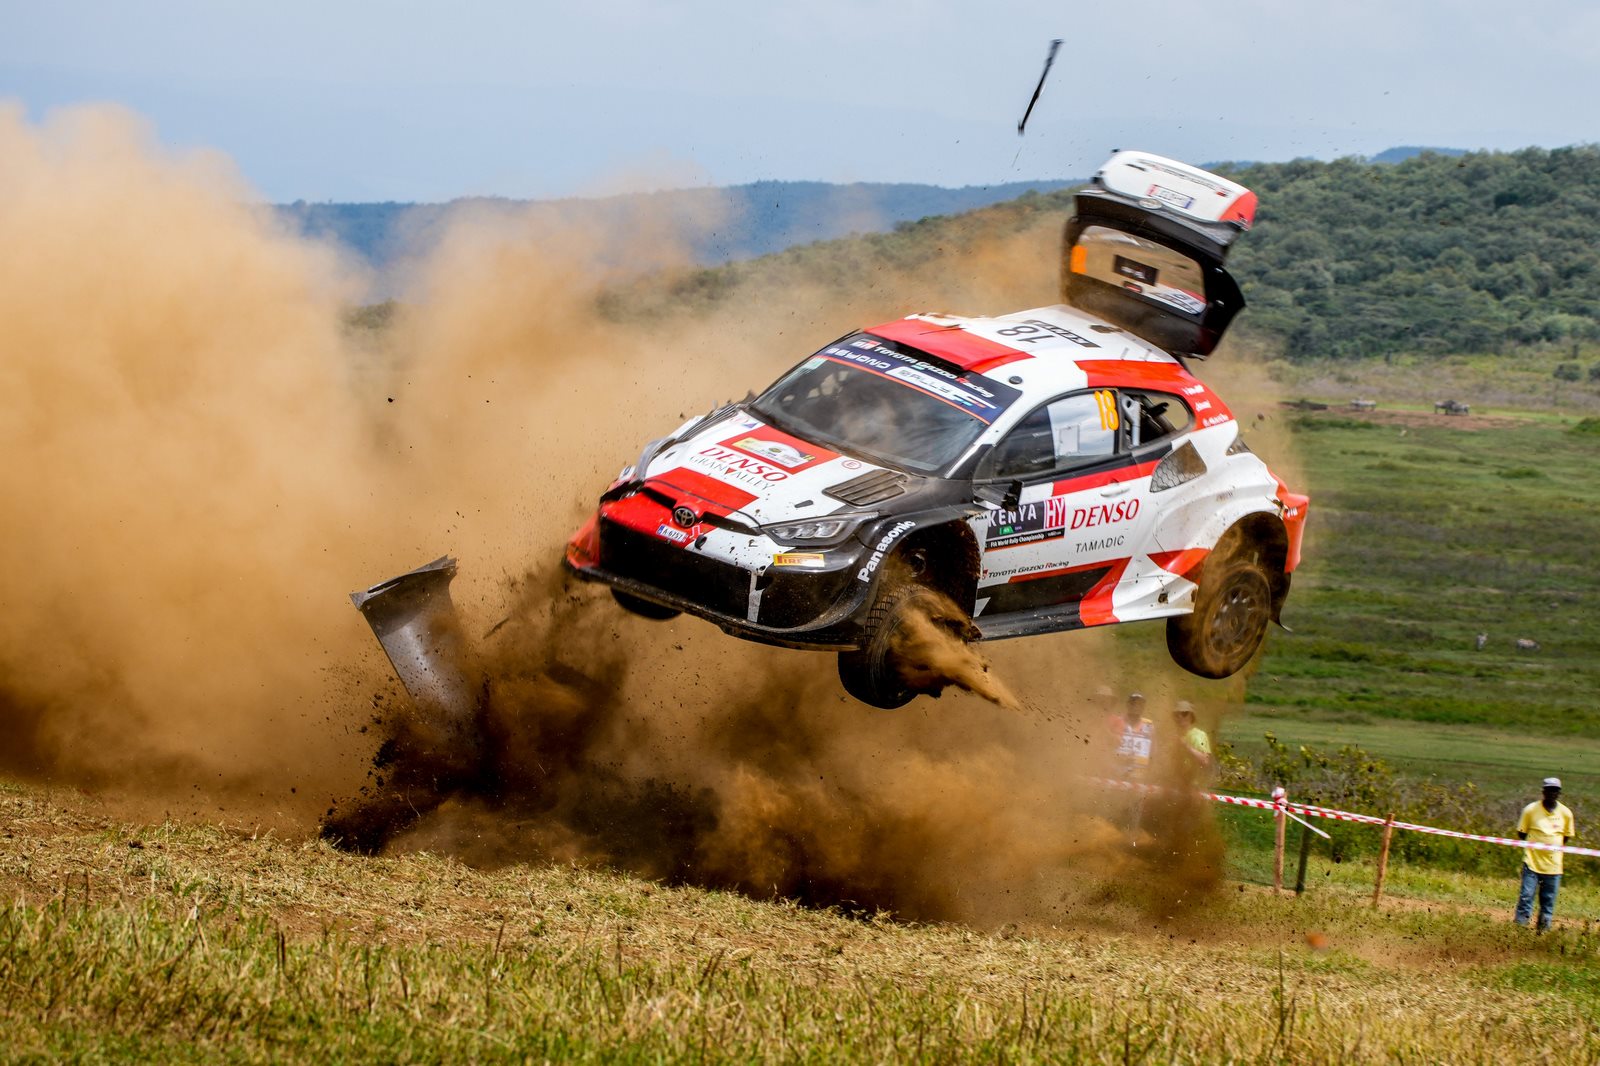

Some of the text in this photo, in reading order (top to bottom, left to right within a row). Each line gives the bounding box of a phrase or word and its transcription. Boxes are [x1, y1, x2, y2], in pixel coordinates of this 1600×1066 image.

[996, 326, 1056, 343] 18
[825, 347, 891, 369] BEYOND
[874, 346, 919, 364] TOYOTA
[912, 361, 958, 380] GAZOO
[955, 377, 995, 398] Racing
[1094, 389, 1119, 431] 18
[698, 447, 788, 482] DENSO
[988, 498, 1065, 529] KENYA HY
[1071, 499, 1139, 530] DENSO
[857, 520, 916, 583] Panasonic
[998, 539, 1009, 547] World
[1019, 533, 1045, 543] Championship
[1075, 535, 1125, 553] TAMADIC
[988, 568, 1016, 579] TOYOTA
[1045, 561, 1069, 569] Racing
